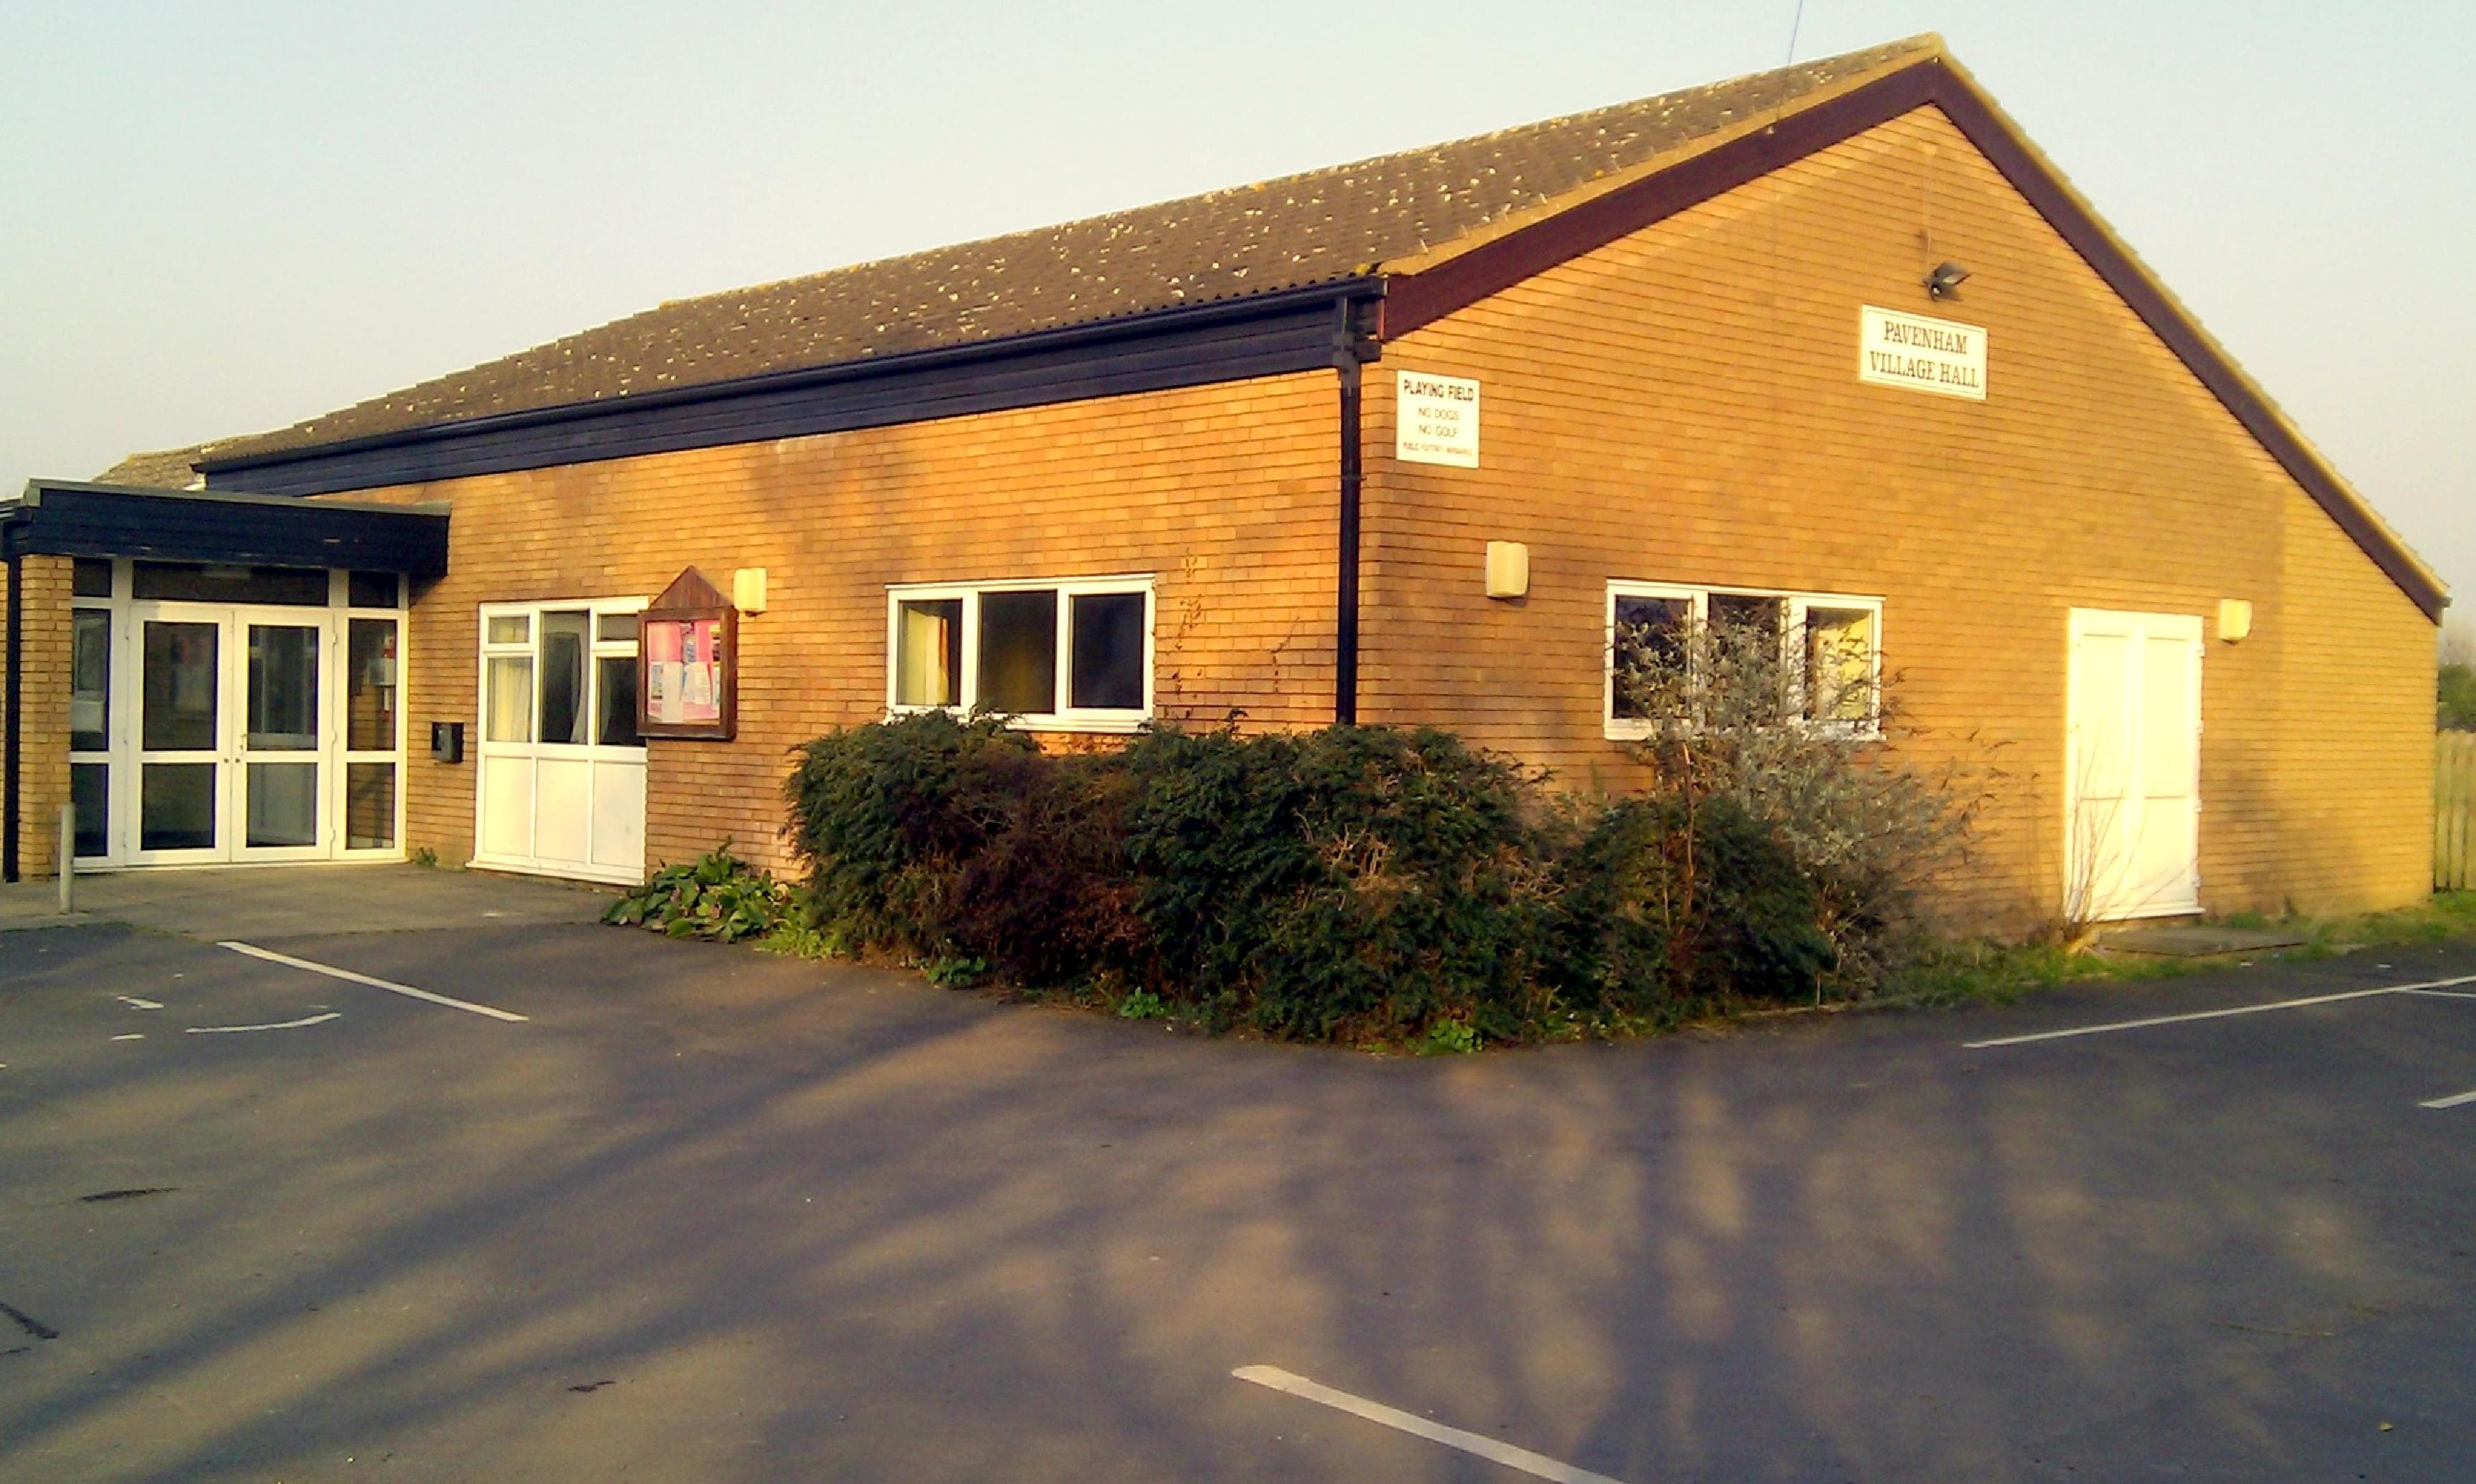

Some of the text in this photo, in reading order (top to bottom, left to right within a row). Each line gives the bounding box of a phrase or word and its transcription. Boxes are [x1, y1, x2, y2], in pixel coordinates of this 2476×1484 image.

[1884, 321, 1967, 355] PAVENHAM
[1870, 351, 1979, 387] VILLAGE HALL
[1403, 380, 1474, 401] PLAYING FIELD
[1419, 408, 1459, 420] NO DOGS
[1419, 425, 1459, 437] NO GOLF
